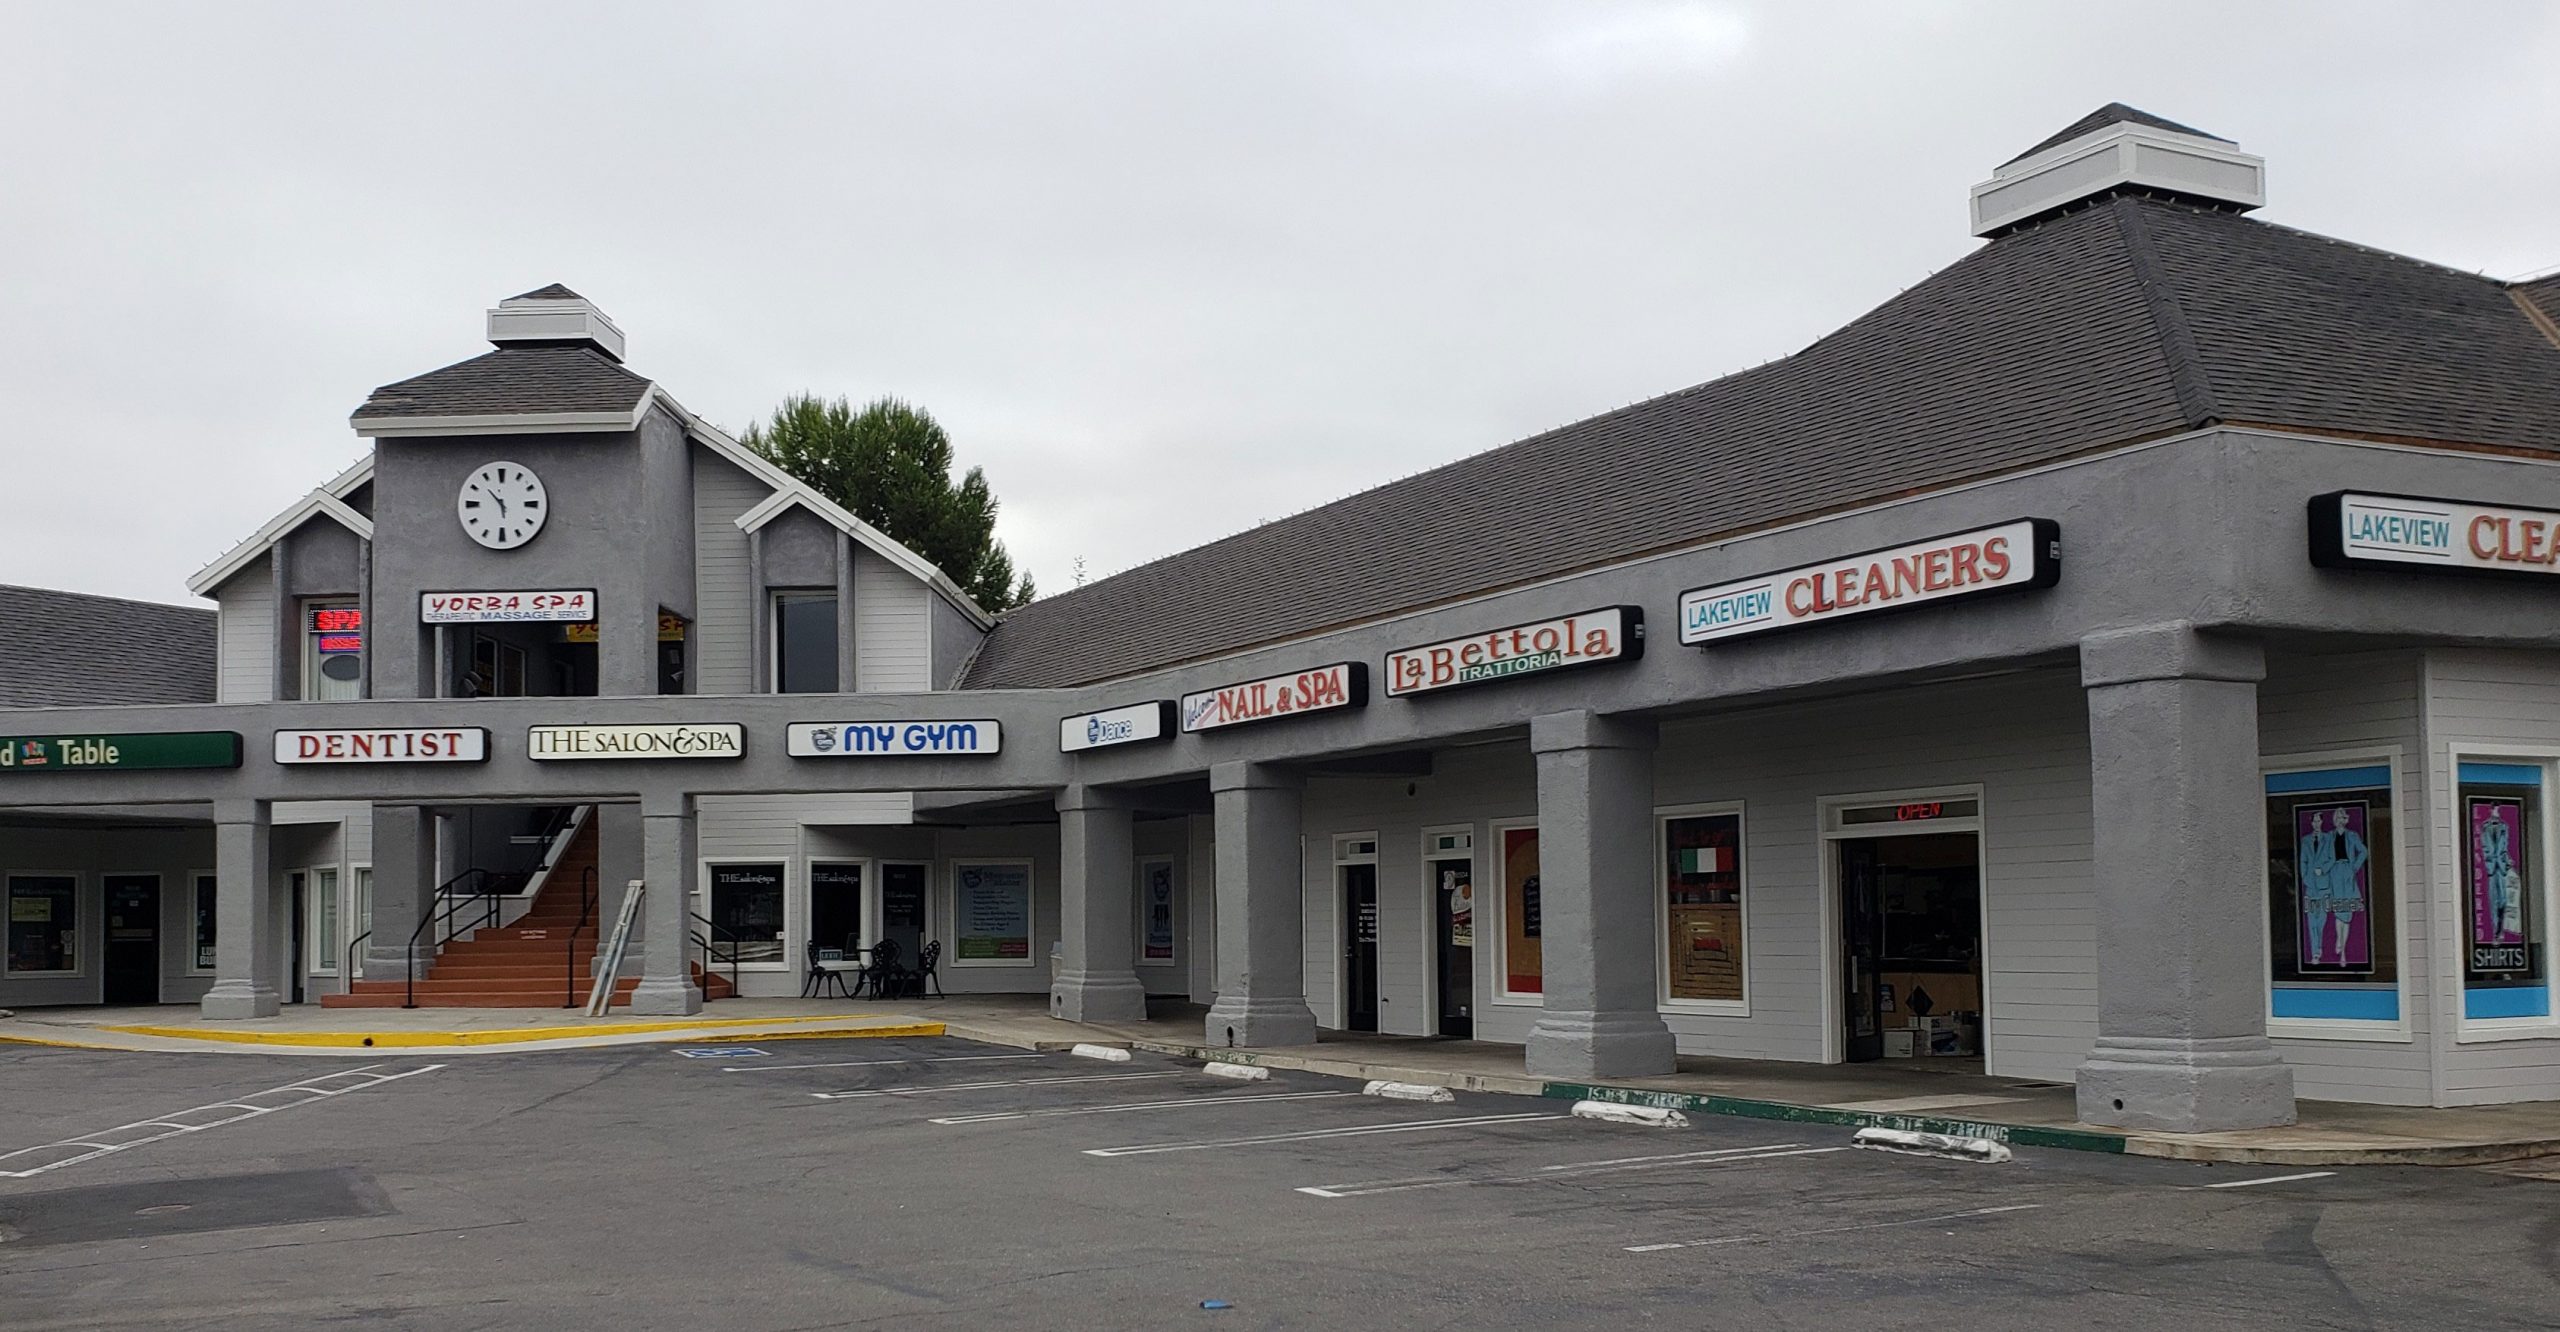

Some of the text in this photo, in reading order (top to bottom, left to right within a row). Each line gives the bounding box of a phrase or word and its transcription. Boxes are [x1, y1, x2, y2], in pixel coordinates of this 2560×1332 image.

[2350, 513, 2450, 548] LAKEVIEW
[1688, 536, 2011, 630] LAKEVIEW CLEANERS
[432, 594, 585, 613] YORBA SPA
[480, 610, 551, 620] MASSAGE
[557, 610, 588, 619] SERVICE
[1460, 652, 1560, 682] TRATTORIA
[1218, 683, 1274, 723] NAIL
[1276, 686, 1293, 713] &
[1295, 668, 1346, 710] SPA
[531, 730, 590, 752] THE
[844, 726, 895, 751] MY
[903, 724, 977, 751] GYM
[1099, 719, 1133, 742] Dance
[57, 739, 120, 765] Table
[298, 733, 463, 758] DENTIST
[1896, 802, 1942, 821] OPEN
[2475, 948, 2524, 967] SHIRTS
[1946, 1121, 2009, 1142] PARKING
